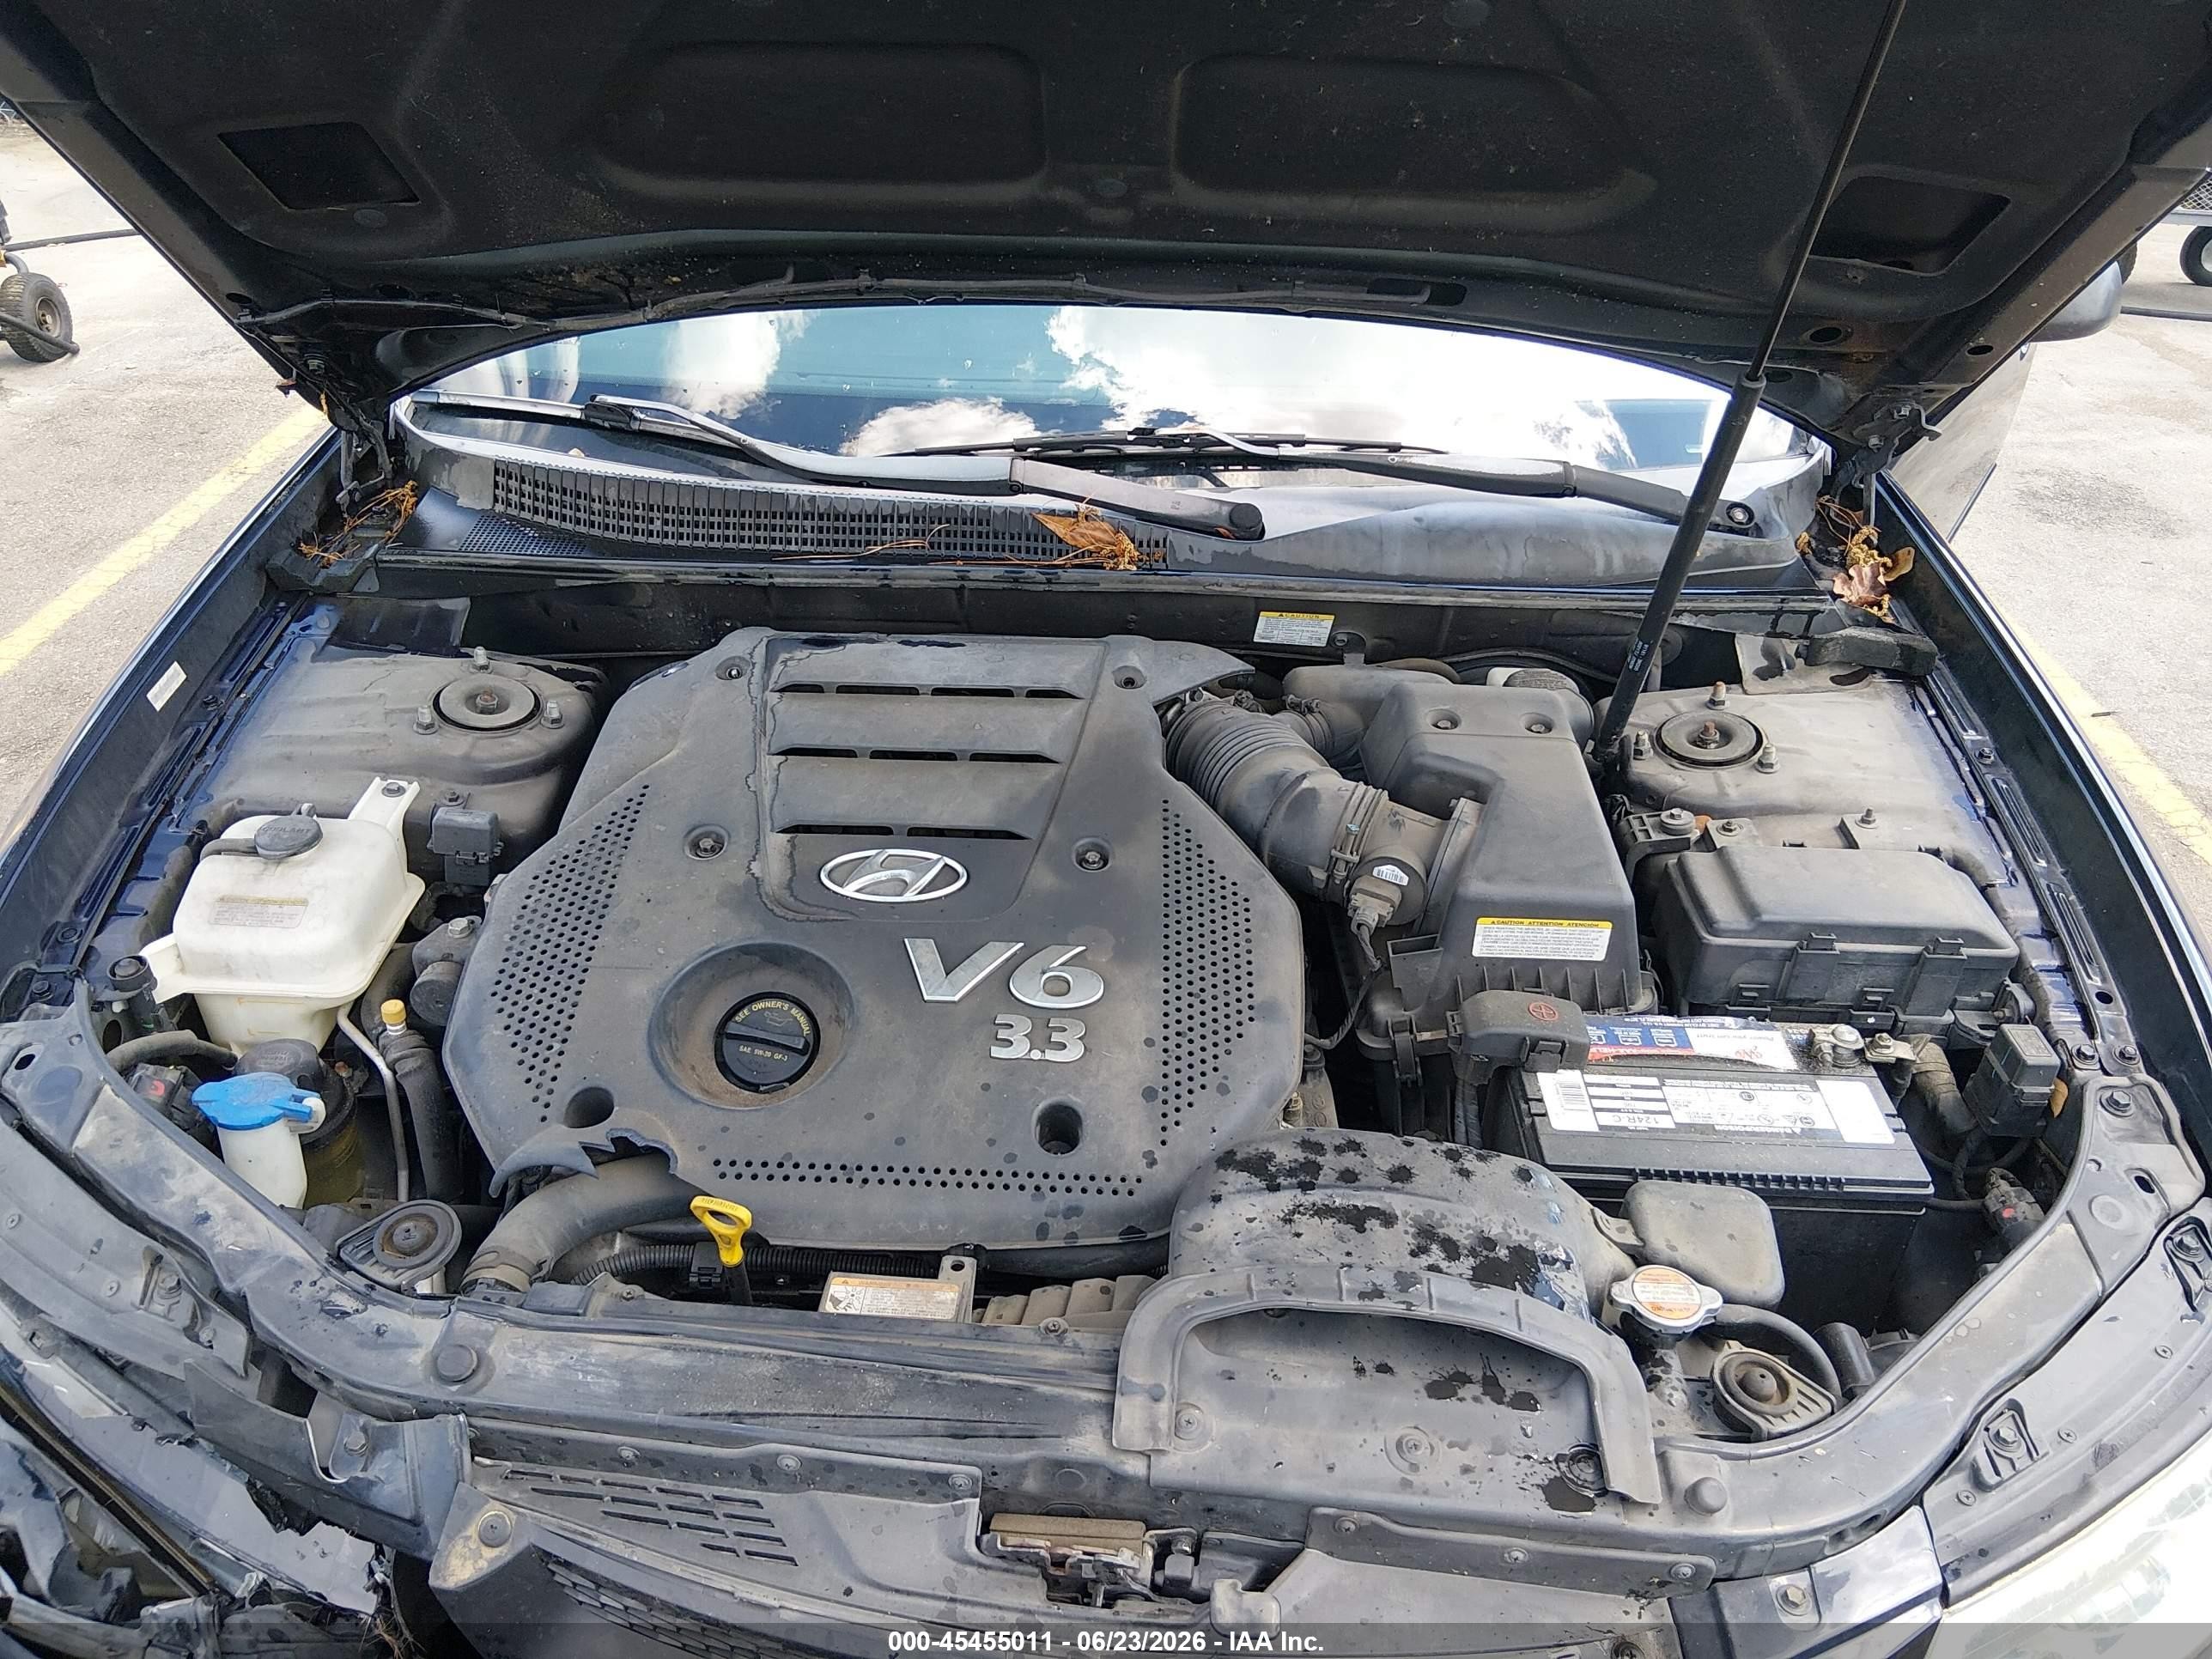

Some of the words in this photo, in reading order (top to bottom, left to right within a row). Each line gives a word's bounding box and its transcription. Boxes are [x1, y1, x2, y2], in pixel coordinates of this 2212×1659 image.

[259, 824, 313, 835] COOLANT
[904, 938, 1105, 1009] V6
[735, 1009, 750, 1023] SEE
[752, 1001, 789, 1011] OWNER'S
[790, 1007, 811, 1036] MANUAL
[739, 1045, 751, 1054] SAE
[989, 1013, 1085, 1062] 3.3
